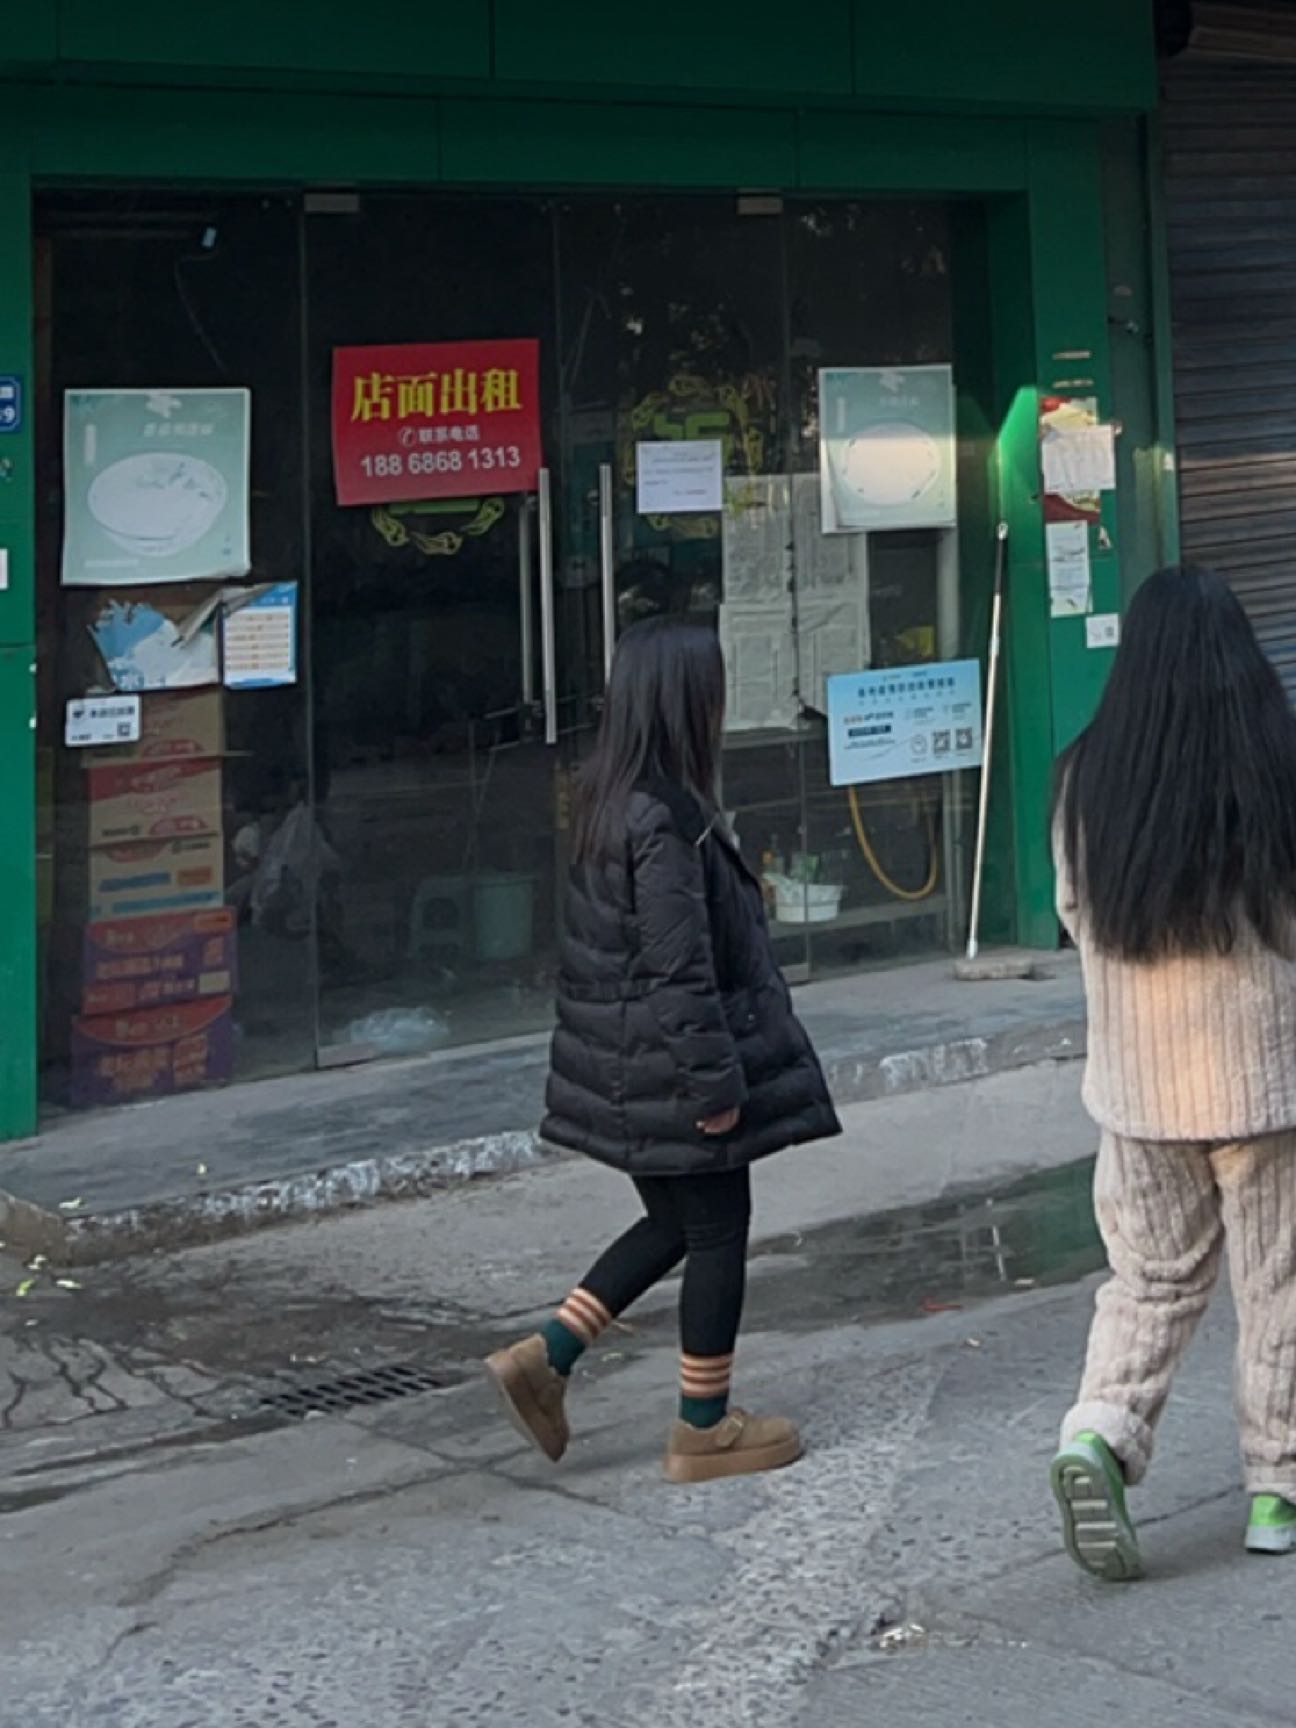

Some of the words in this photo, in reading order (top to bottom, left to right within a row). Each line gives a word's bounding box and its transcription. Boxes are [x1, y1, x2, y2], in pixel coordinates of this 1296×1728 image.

[351, 368, 523, 422] 店面出租
[361, 454, 402, 477] 188
[408, 450, 462, 474] 6868
[468, 445, 521, 469] 1313
